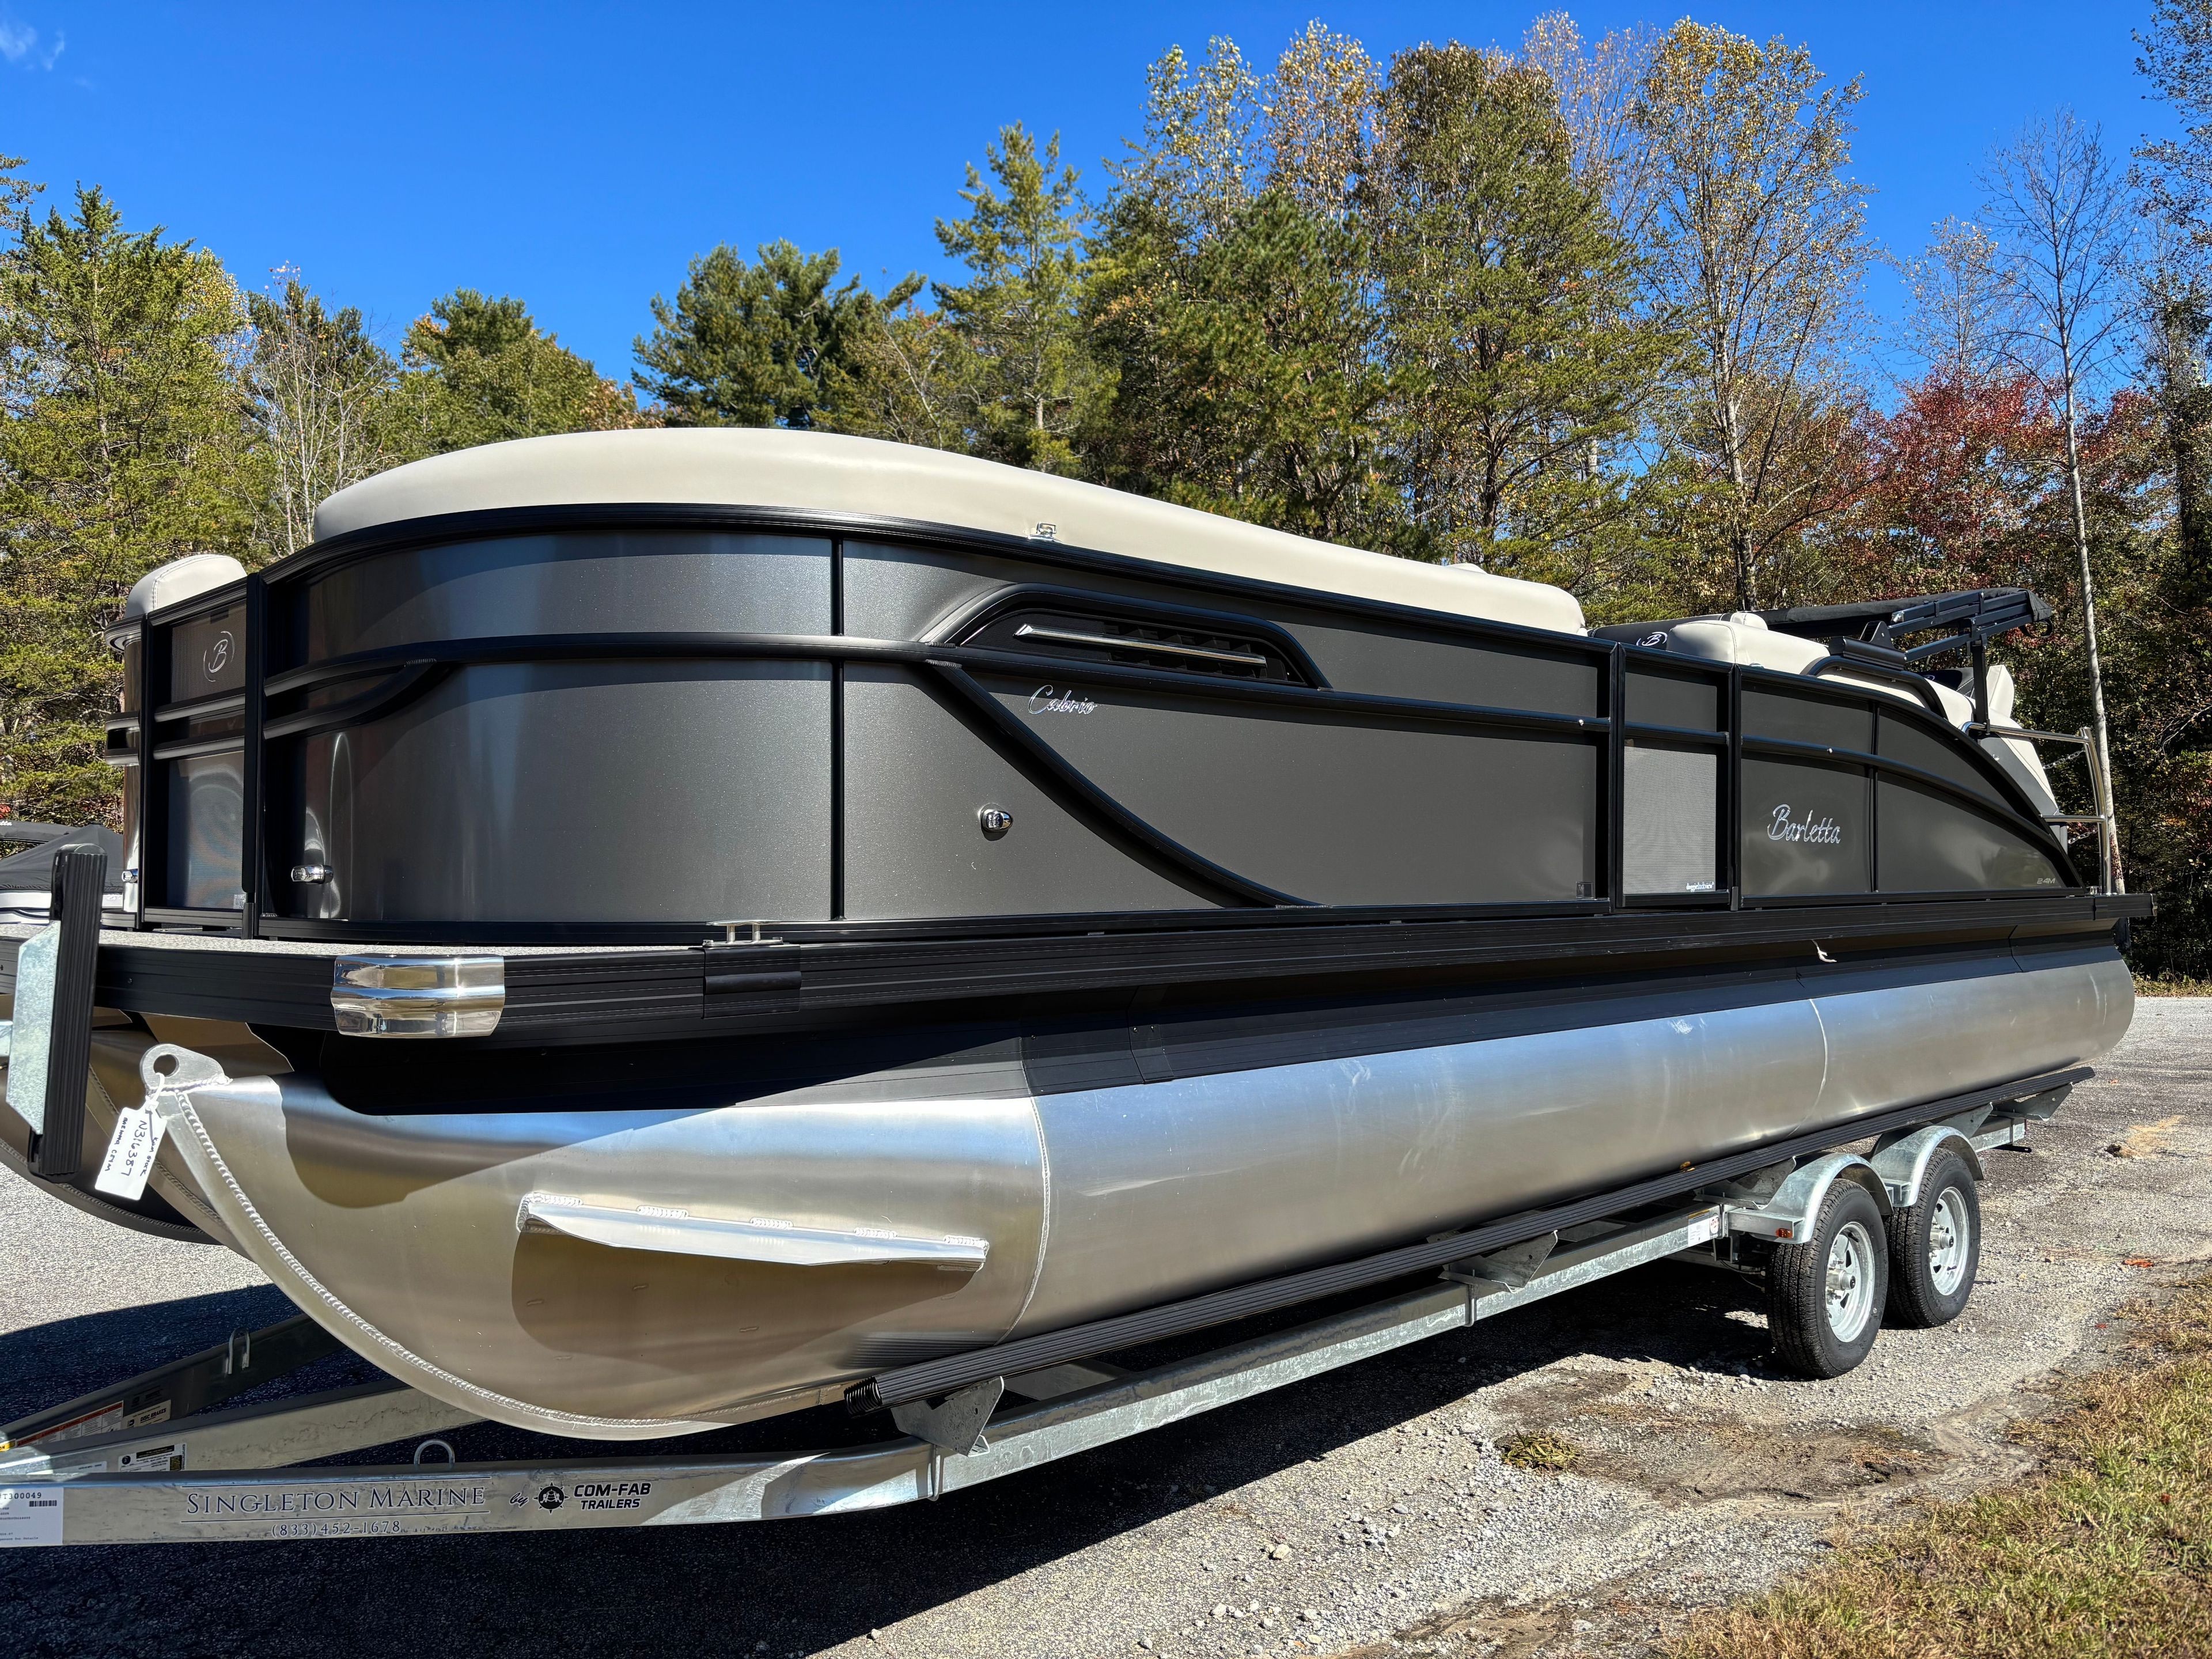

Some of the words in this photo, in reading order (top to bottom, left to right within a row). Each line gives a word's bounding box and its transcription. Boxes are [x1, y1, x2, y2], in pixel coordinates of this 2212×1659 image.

[1028, 684, 1097, 714] Cabrio
[1767, 804, 1841, 844] Barletta
[121, 1120, 147, 1176] N316387
[187, 1491, 359, 1514] SINGLETON
[369, 1486, 486, 1508] MARINE
[510, 1492, 528, 1506] by
[574, 1483, 651, 1497] COM-FAB
[581, 1498, 641, 1510] TRAILERS
[272, 1520, 400, 1537] (833)452-1678
